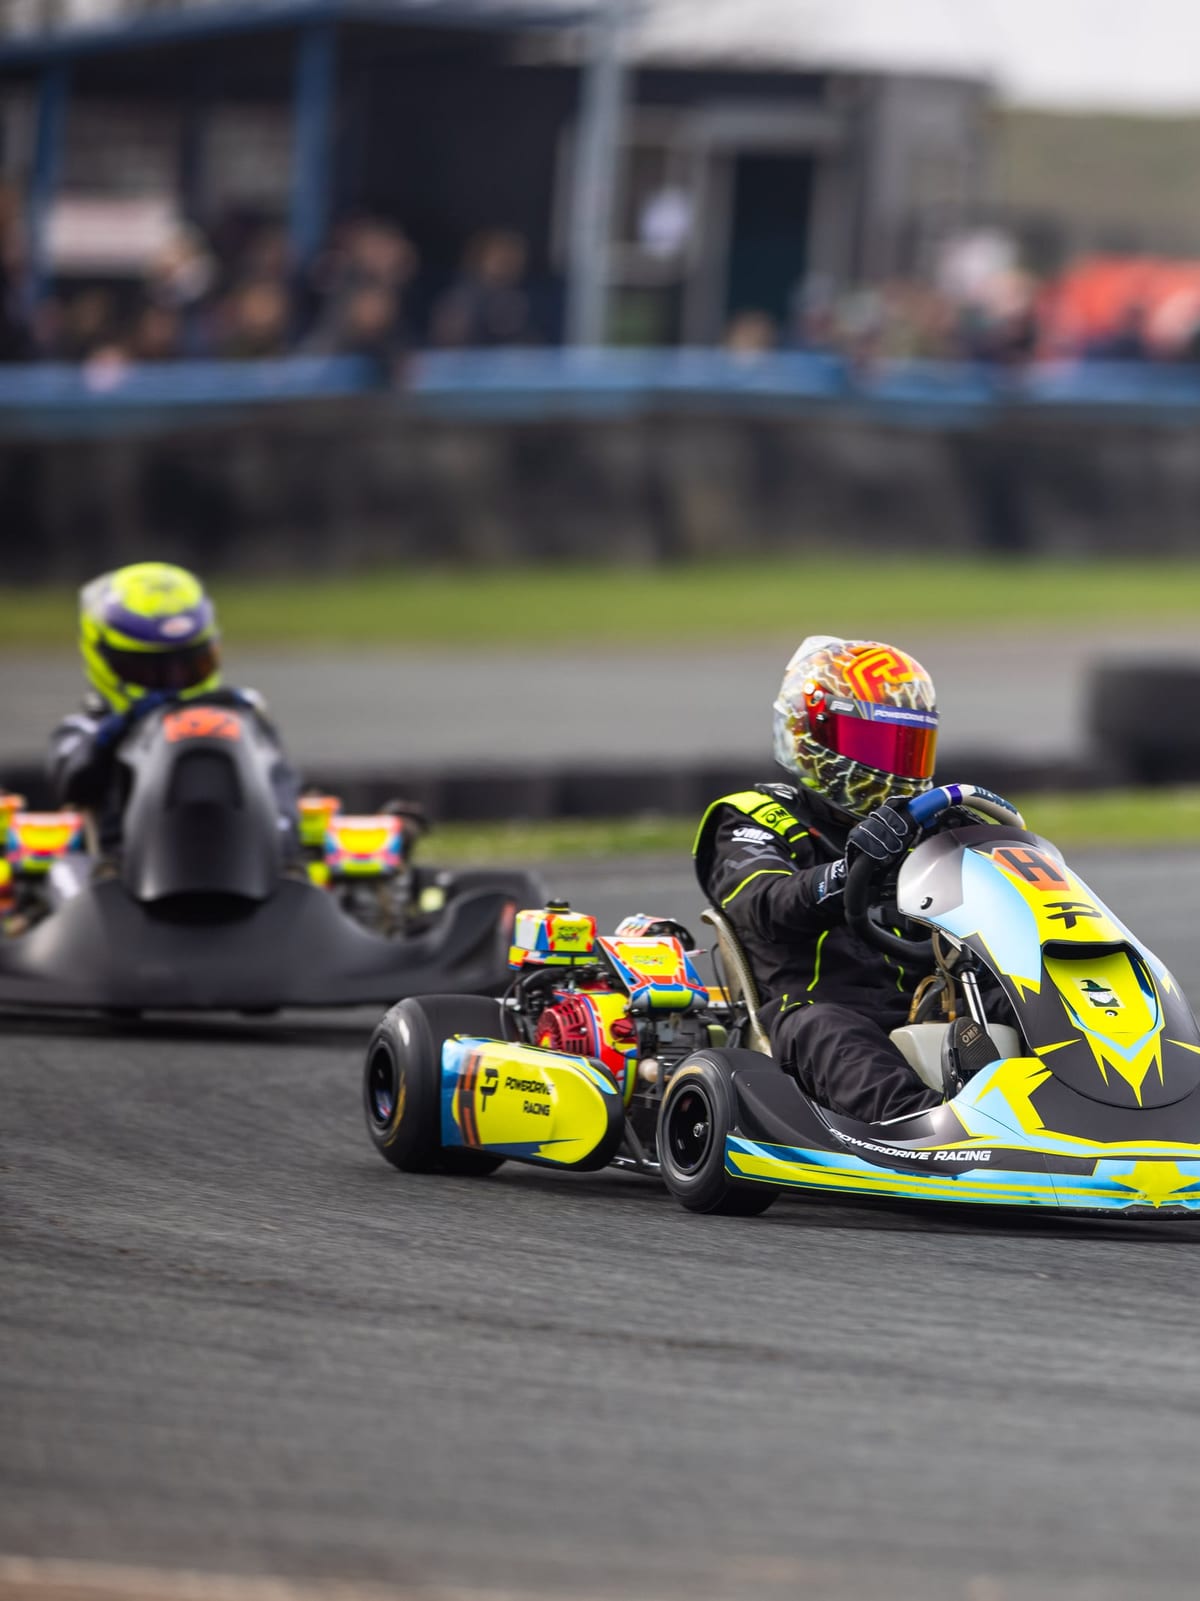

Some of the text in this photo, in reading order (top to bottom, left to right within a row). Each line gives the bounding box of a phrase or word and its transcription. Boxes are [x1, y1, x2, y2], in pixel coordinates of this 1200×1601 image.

[732, 827, 775, 841] OMP
[996, 849, 1066, 882] H
[961, 1026, 979, 1044] OMP
[505, 1076, 554, 1096] POWERDRIVE
[524, 1100, 551, 1117] RACING
[829, 1128, 992, 1161] POWERDRIVE RACING
